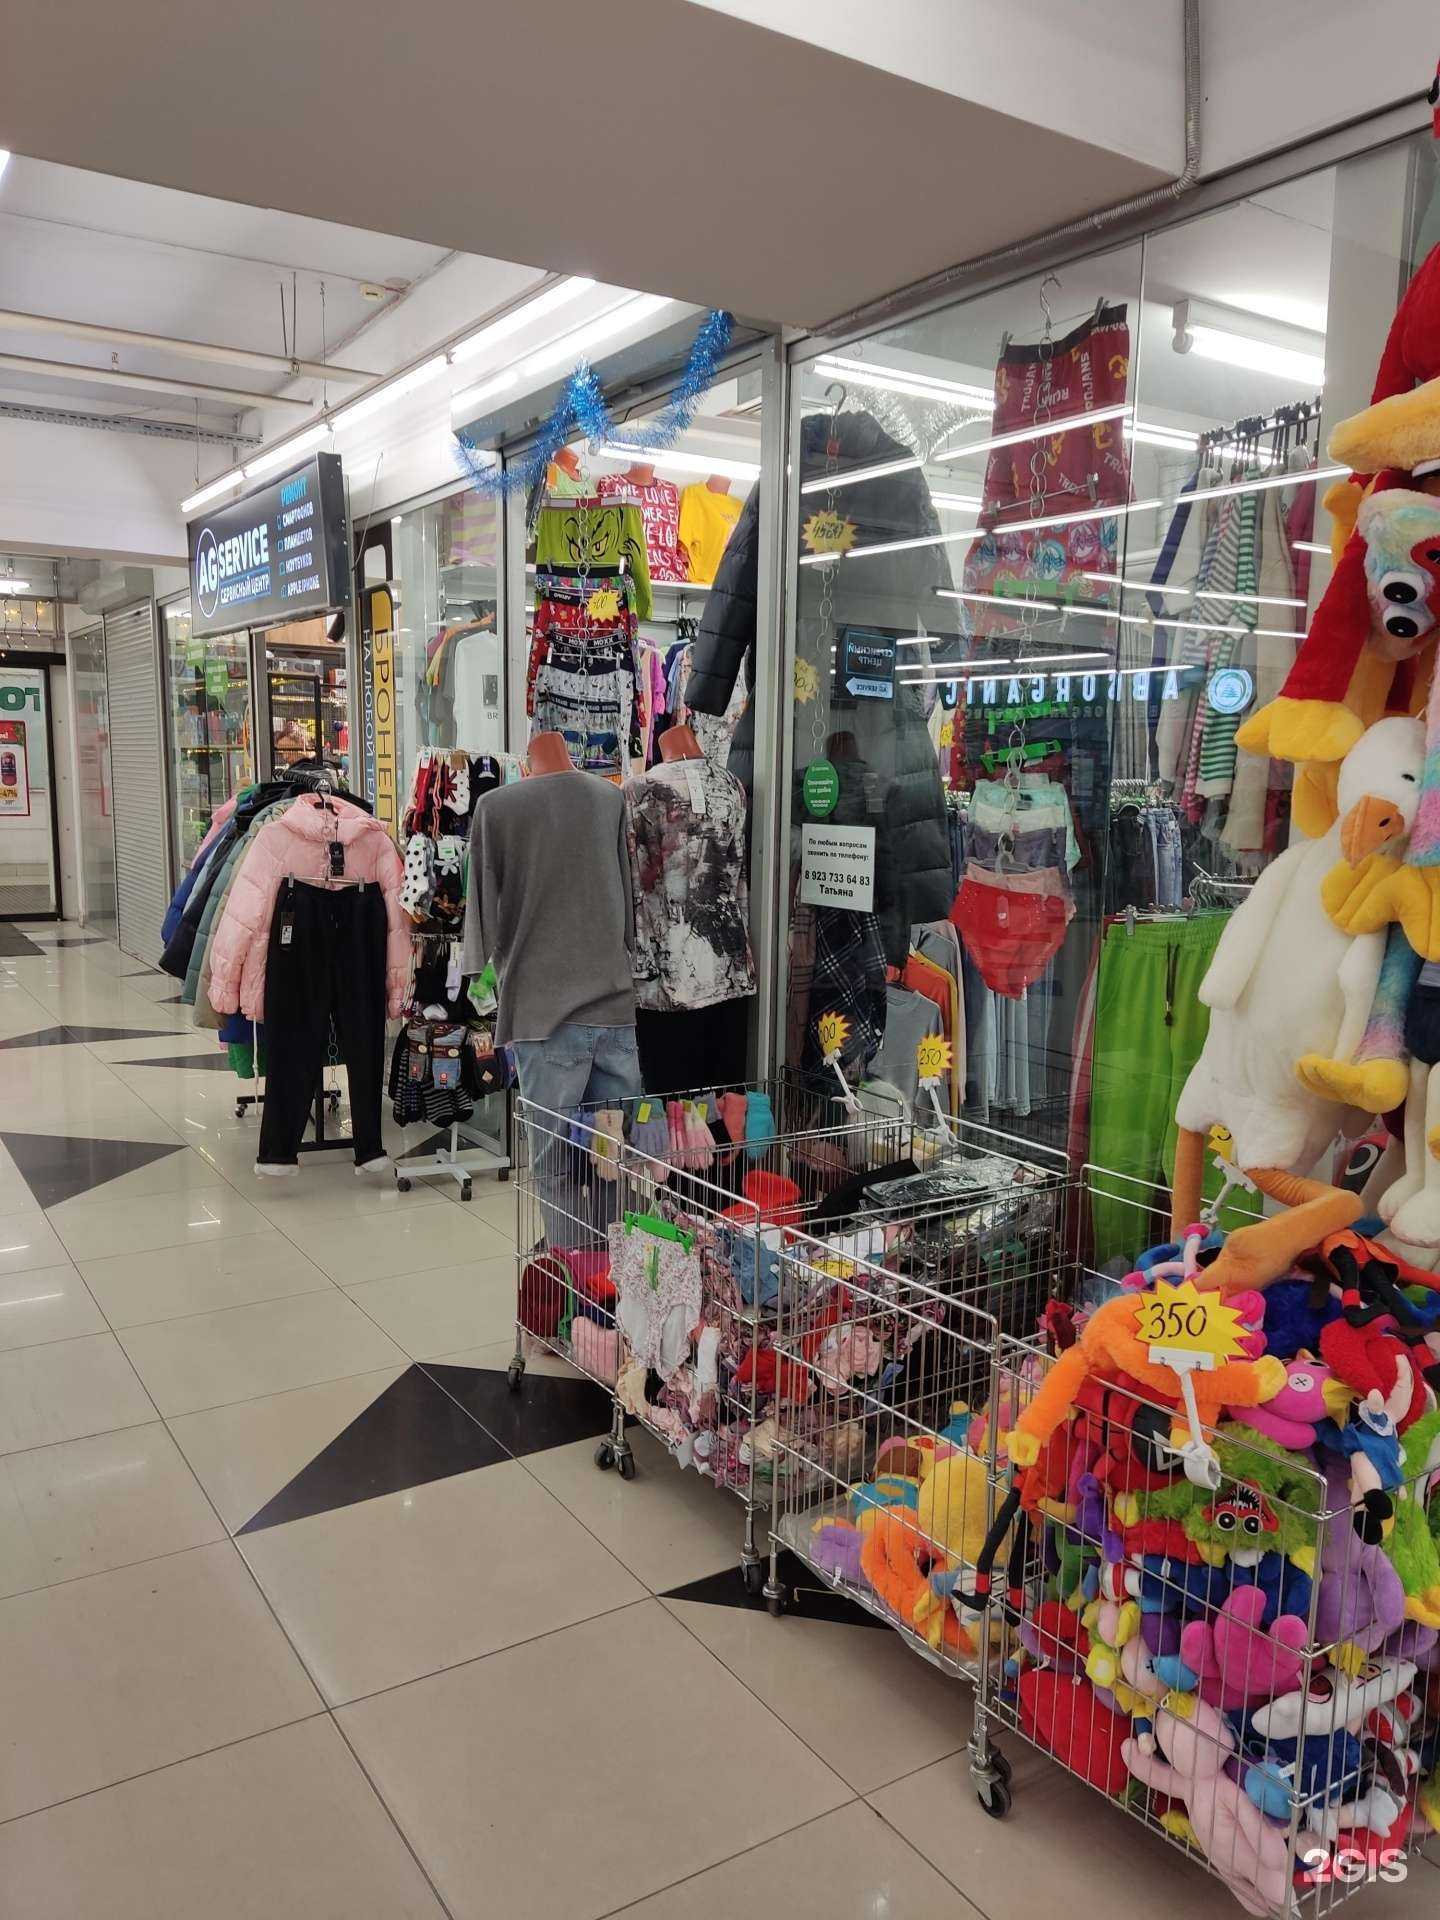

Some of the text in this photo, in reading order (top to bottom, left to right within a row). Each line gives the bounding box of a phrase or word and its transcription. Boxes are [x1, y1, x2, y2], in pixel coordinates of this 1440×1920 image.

[218, 523, 269, 579] SERVICE
[221, 574, 269, 604] СЕРВИСНЫЙ ЦЕНТР
[364, 673, 375, 756] ЛЮБОЙ
[839, 841, 868, 849] вопросам
[804, 870, 870, 886] 8 923 733 64 83
[819, 884, 854, 897] Татьяна
[920, 1047, 942, 1066] 250
[1148, 1302, 1208, 1339] 350
